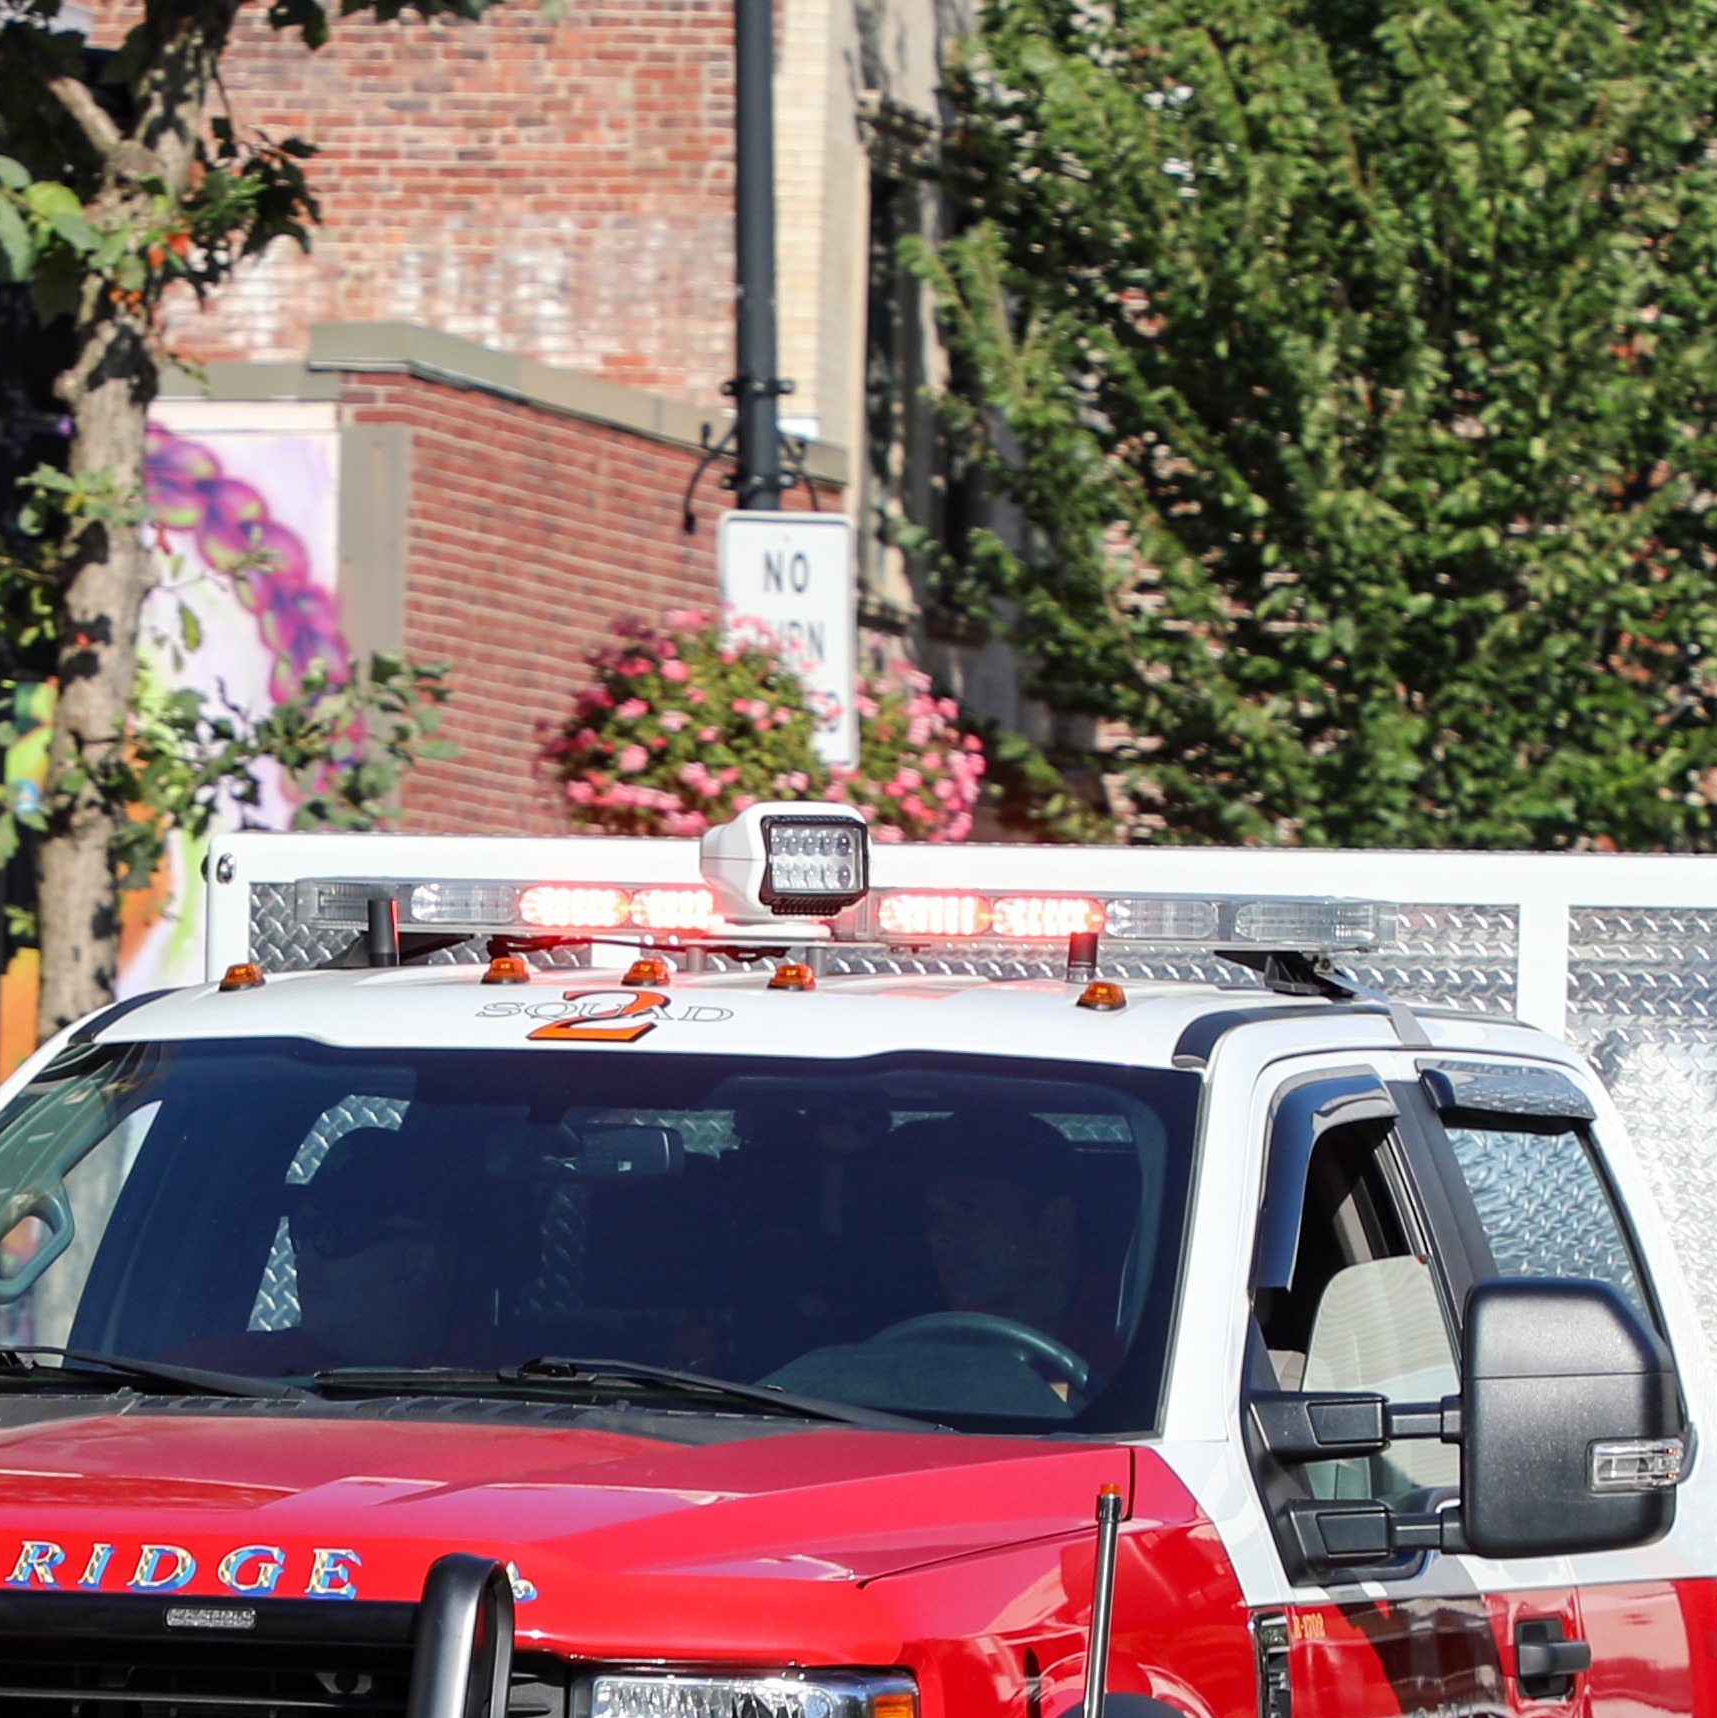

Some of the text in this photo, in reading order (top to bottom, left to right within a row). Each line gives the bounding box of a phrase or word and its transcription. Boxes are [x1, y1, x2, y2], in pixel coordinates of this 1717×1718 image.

[764, 549, 811, 594] NO
[475, 1001, 734, 1022] SQUAD
[526, 990, 672, 1043] 2
